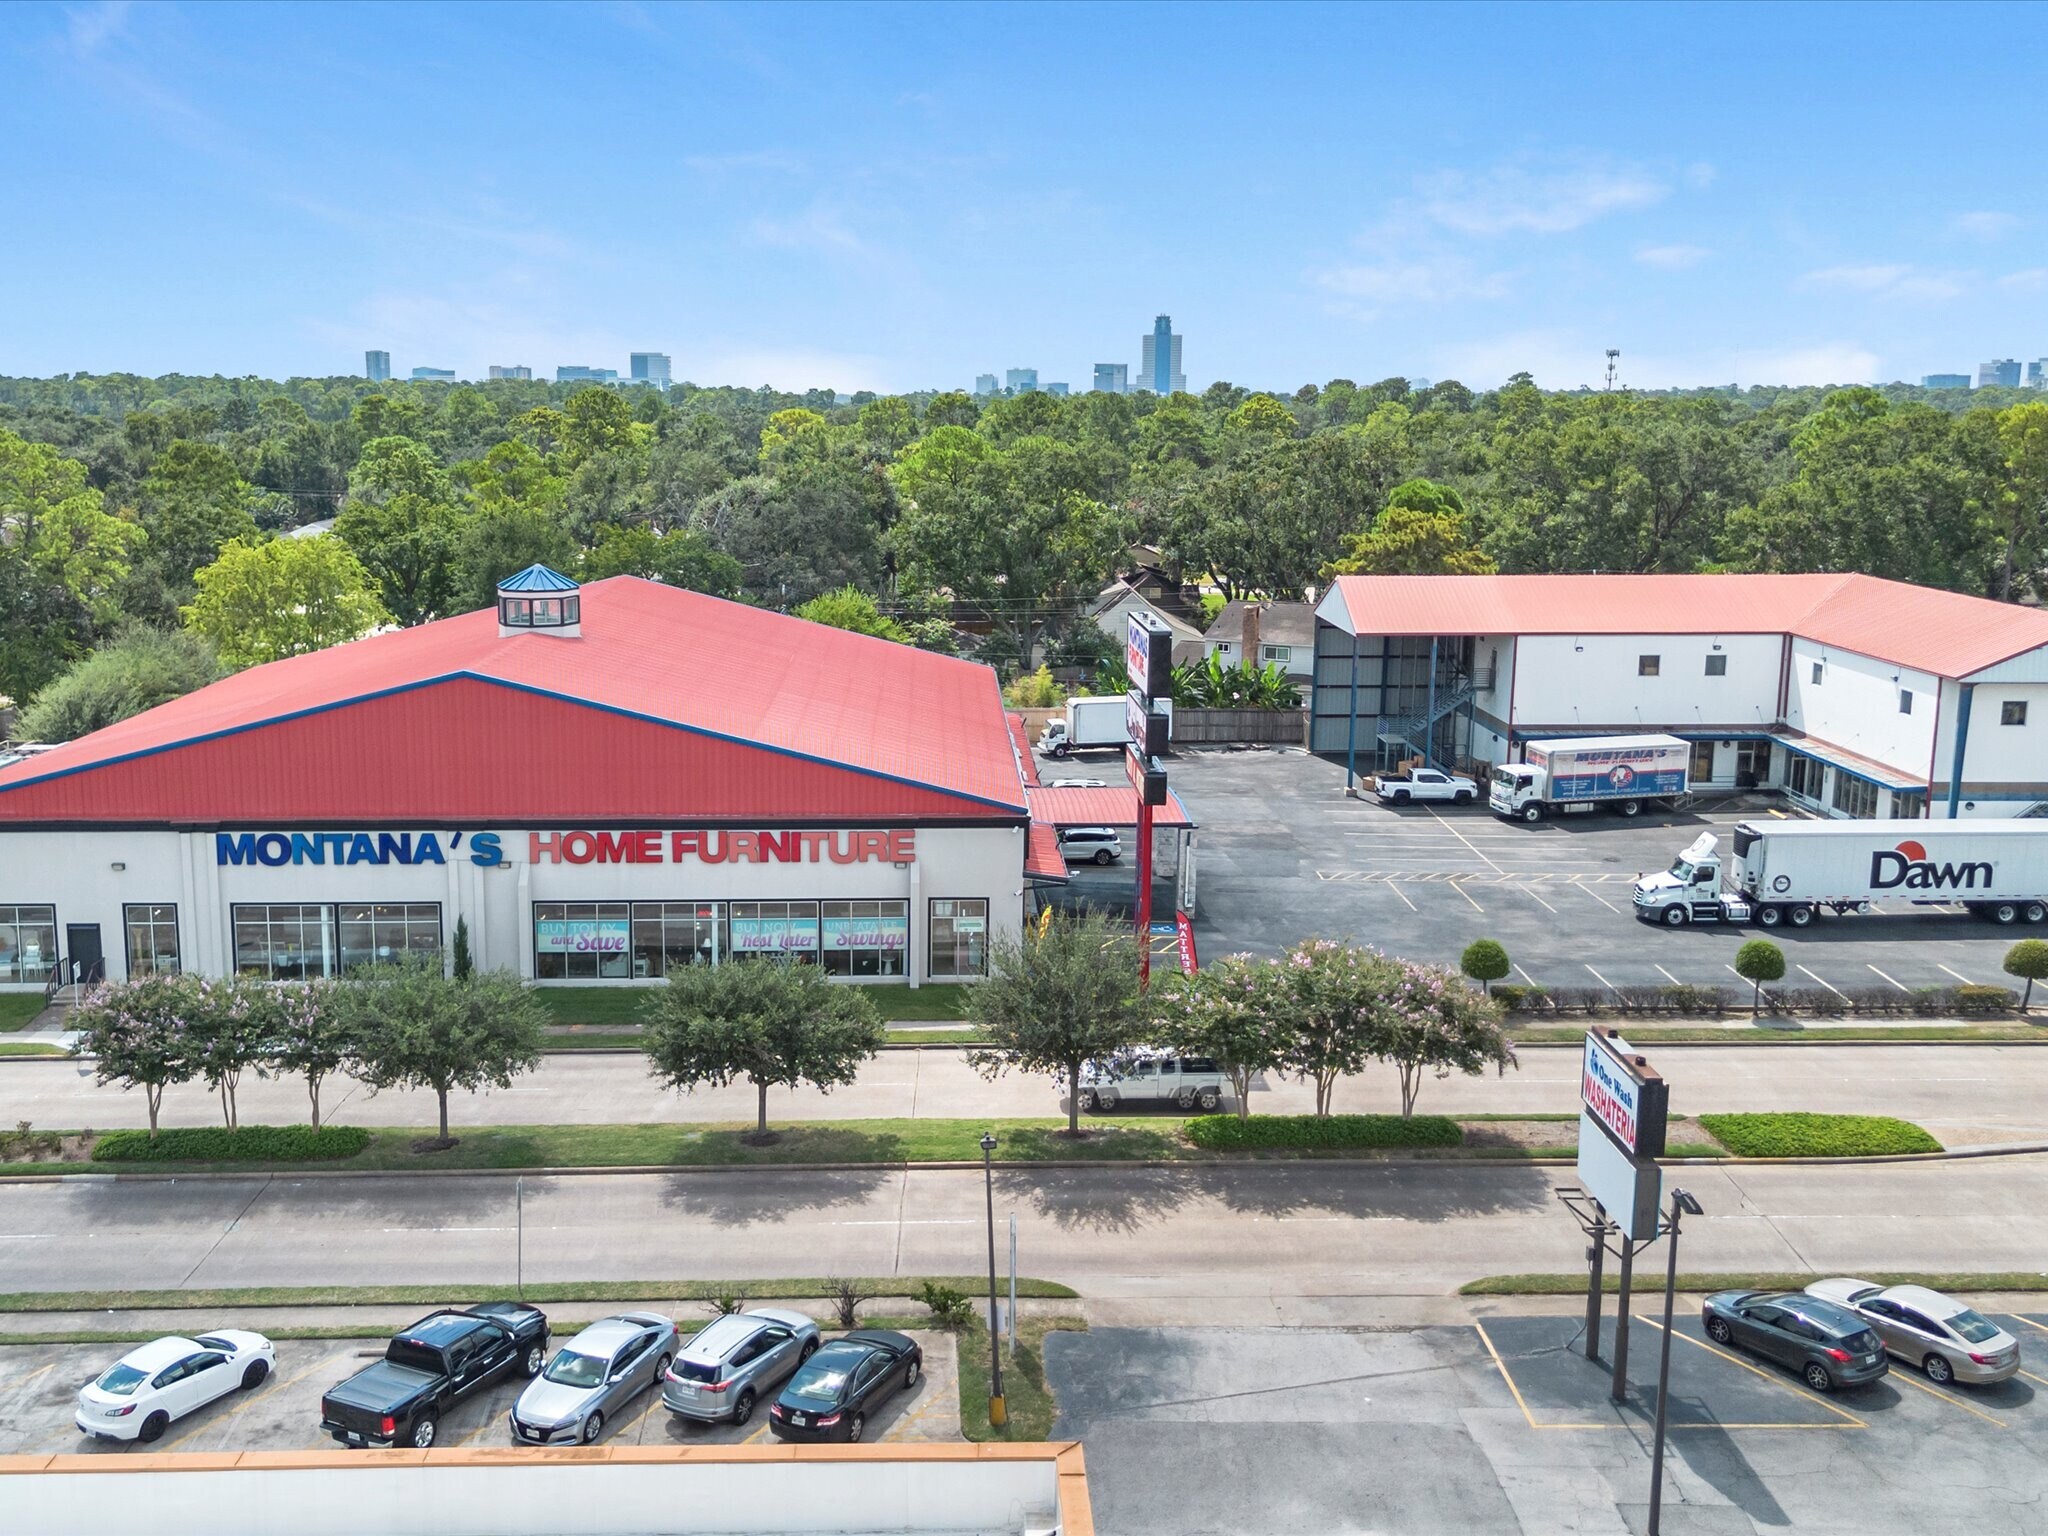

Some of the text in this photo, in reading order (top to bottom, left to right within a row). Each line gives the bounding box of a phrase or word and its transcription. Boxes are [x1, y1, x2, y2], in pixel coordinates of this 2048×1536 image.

[1574, 749, 1667, 762] MONTANA'S
[216, 830, 915, 866] MONTANA'S HOME FURNITURE
[1869, 851, 1993, 889] Dawn
[540, 923, 566, 934] BUY
[734, 922, 760, 933] BUY
[551, 932, 626, 951] and Save
[836, 930, 905, 951] Savings
[1599, 1065, 1633, 1110] One Wash
[1584, 1071, 1635, 1148] WASHATERIA
